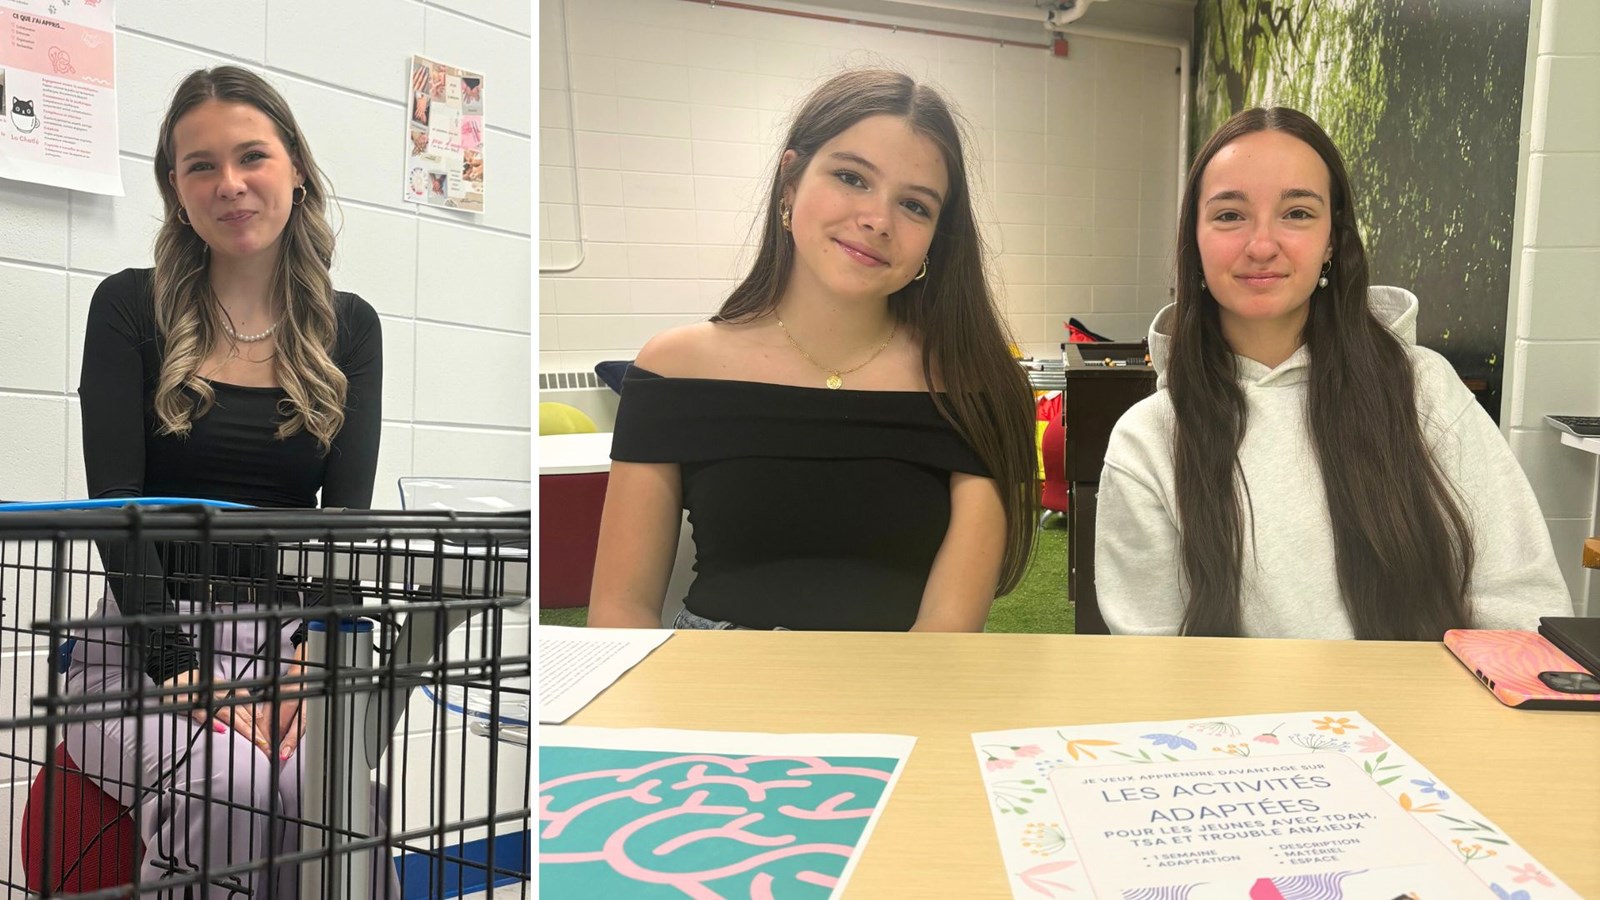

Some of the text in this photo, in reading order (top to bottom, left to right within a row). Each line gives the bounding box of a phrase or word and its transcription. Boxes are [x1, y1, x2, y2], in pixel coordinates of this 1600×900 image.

[20, 14, 31, 22] QUE
[1100, 775, 1135, 784] VEUX
[1139, 770, 1215, 781] APPRENDRE
[1301, 763, 1326, 771] SUR
[1102, 774, 1332, 803] LES ACTIVITÉS
[1150, 797, 1321, 823] ADAPTÉES
[1104, 811, 1377, 839] POUR LES JEUNES AVEC TDAH,
[1130, 821, 1365, 848] TSA ET TROUBLE ANXIEUX
[1278, 837, 1361, 851] DESCRIPTION
[1160, 848, 1218, 860] SEMAINE
[1285, 845, 1346, 858] MATÉRIEL
[1158, 854, 1241, 868] ADAPTATION
[1290, 855, 1340, 865] ESPACE
